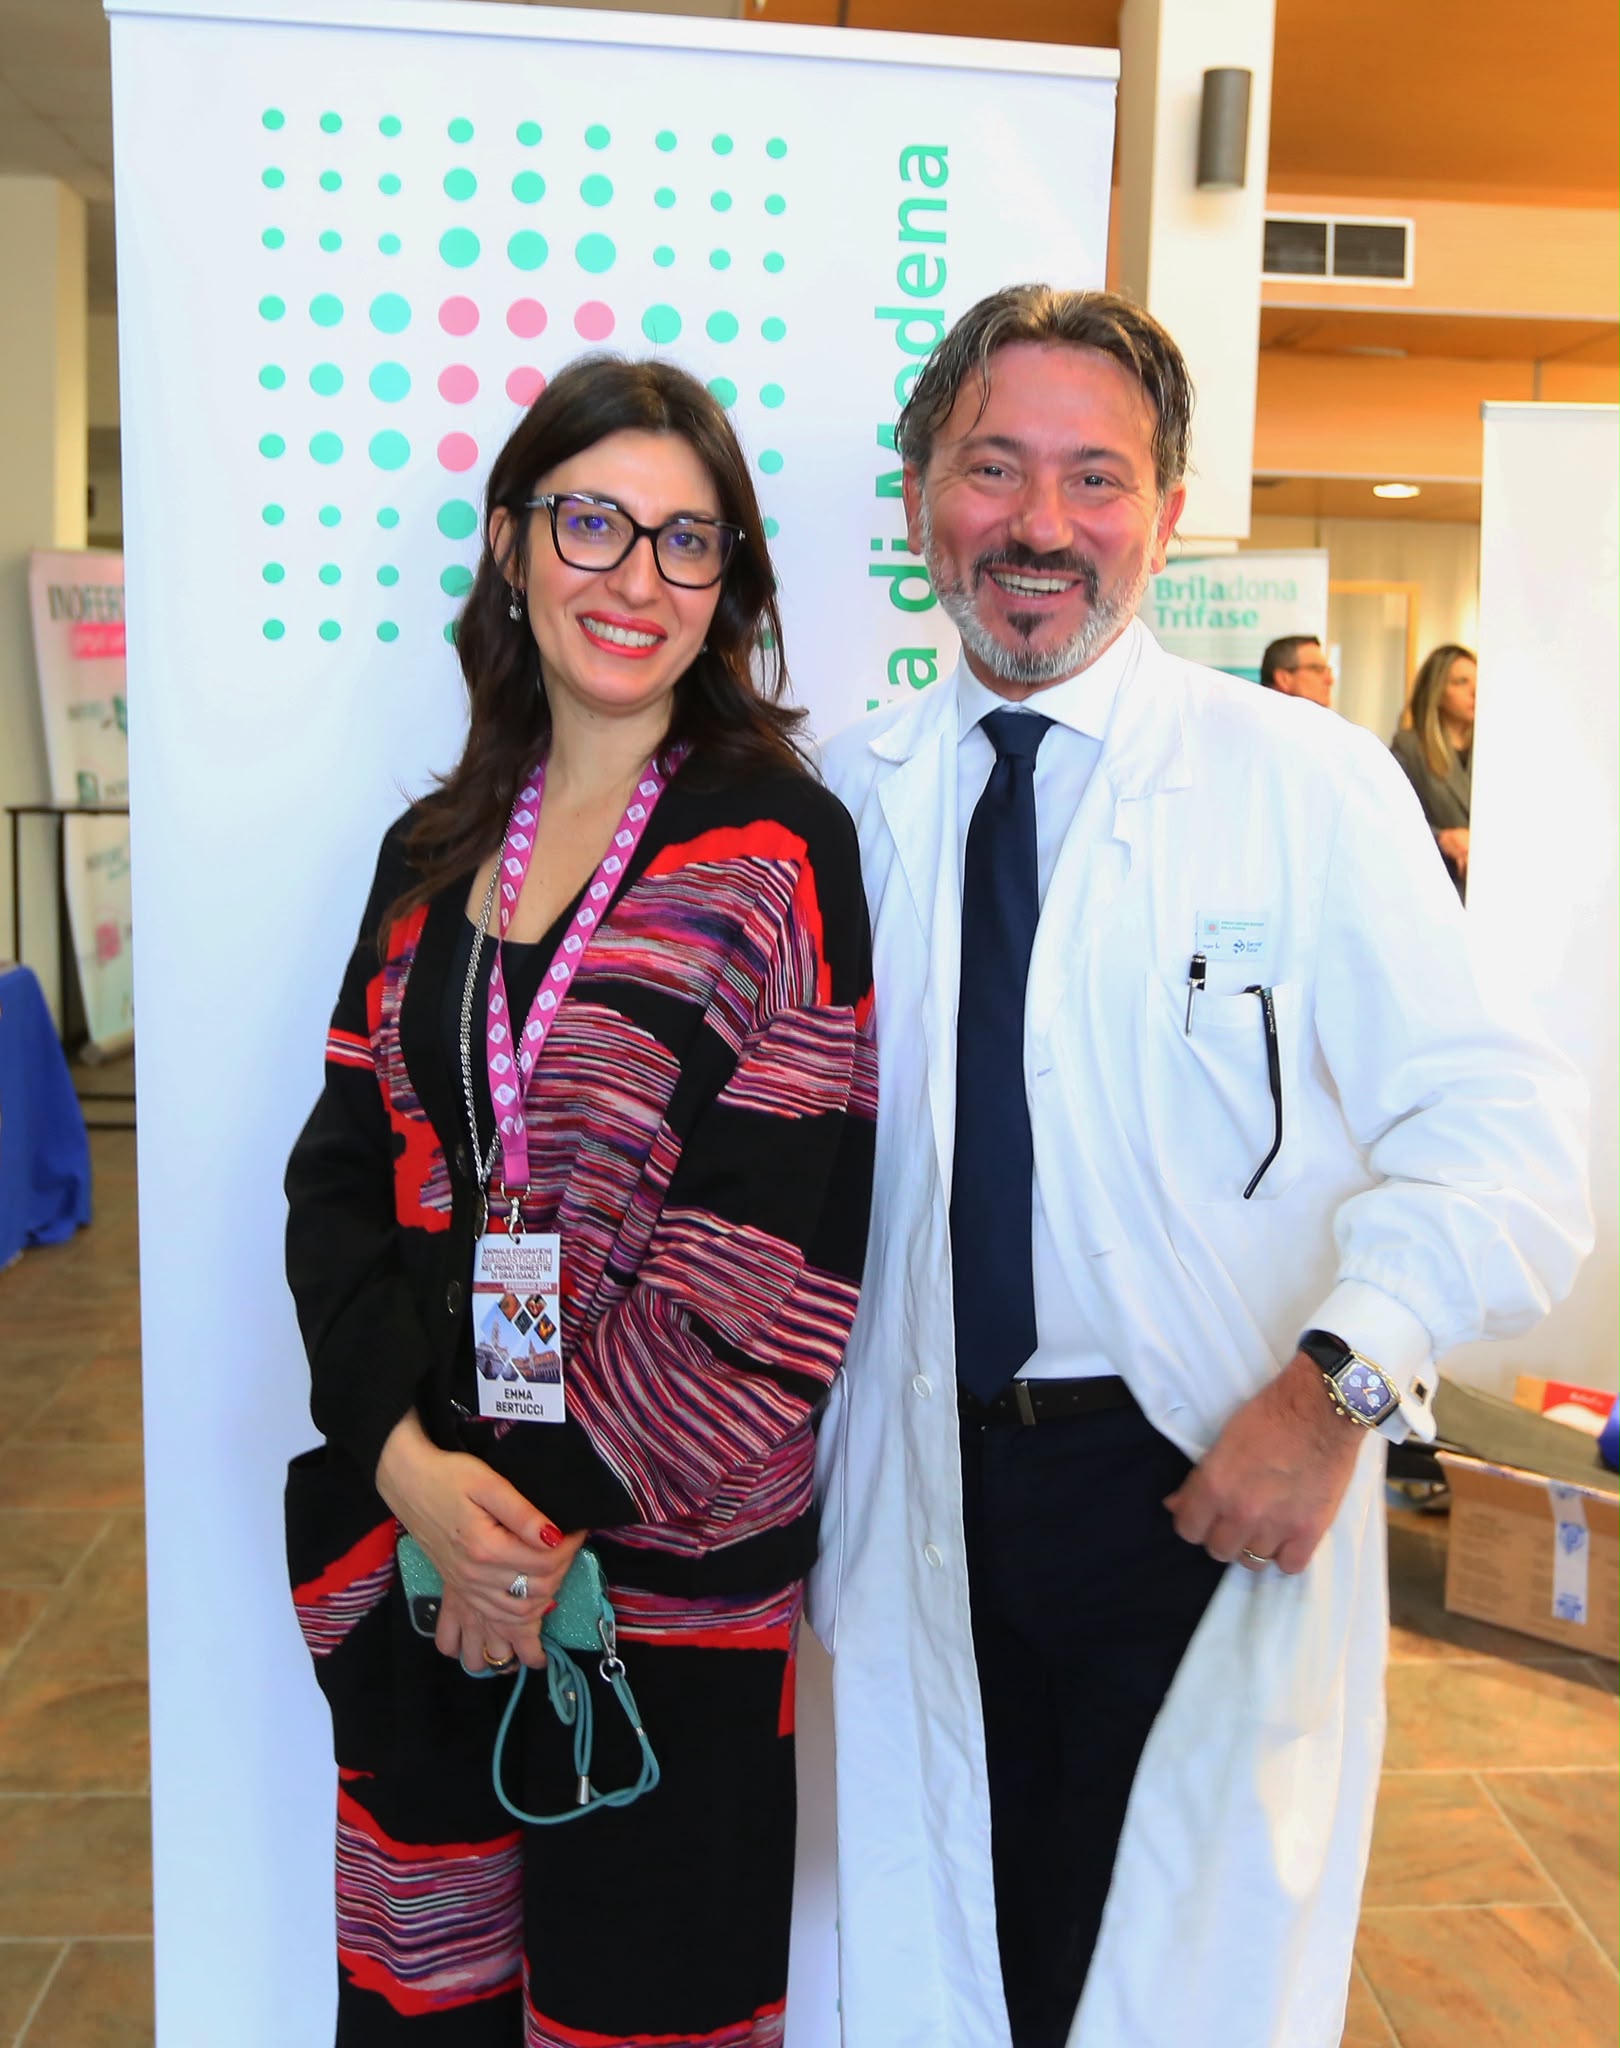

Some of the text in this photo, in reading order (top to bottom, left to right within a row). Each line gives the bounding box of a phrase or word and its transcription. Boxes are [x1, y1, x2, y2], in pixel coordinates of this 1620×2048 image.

[869, 537, 938, 612] di
[1155, 575, 1298, 602] Briladona
[1154, 601, 1259, 628] Trifase
[482, 1255, 552, 1264] DIAGNOSTICABILI
[495, 1264, 515, 1272] PRIMO
[516, 1264, 552, 1272] TRIMESTRE
[498, 1272, 541, 1280] GRAVIDANZA
[504, 1388, 533, 1400] EMMA
[495, 1401, 544, 1416] BERTUCCI
